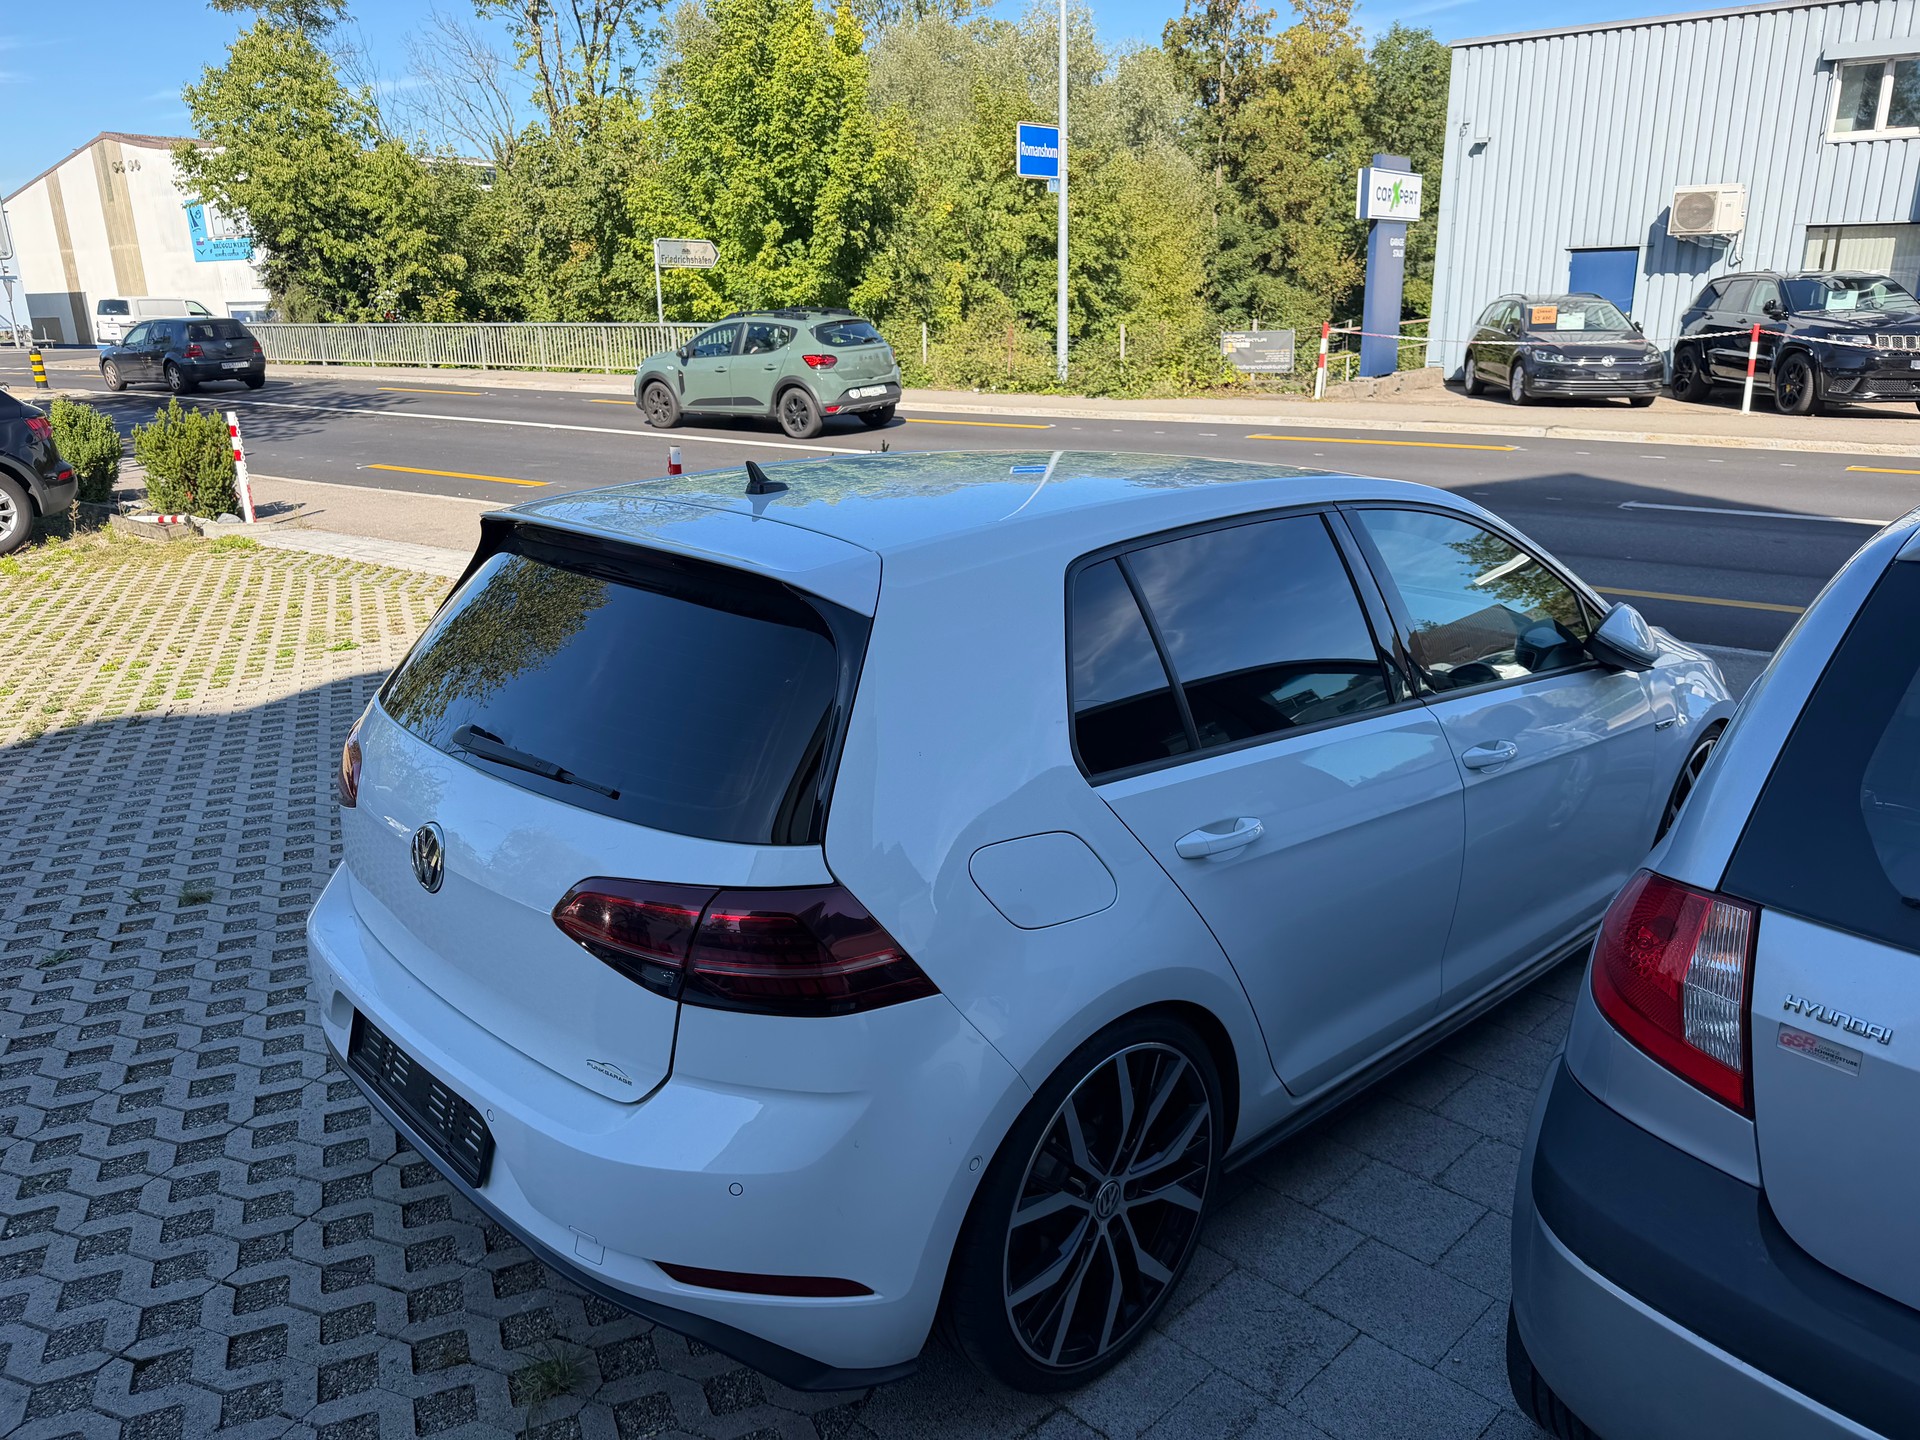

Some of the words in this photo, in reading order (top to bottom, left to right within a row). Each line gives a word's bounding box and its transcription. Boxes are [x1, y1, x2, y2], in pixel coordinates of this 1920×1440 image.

[1020, 141, 1058, 159] Romanshorn
[661, 254, 712, 265] Friedrichshafen
[1783, 993, 1894, 1046] HYUNDAI
